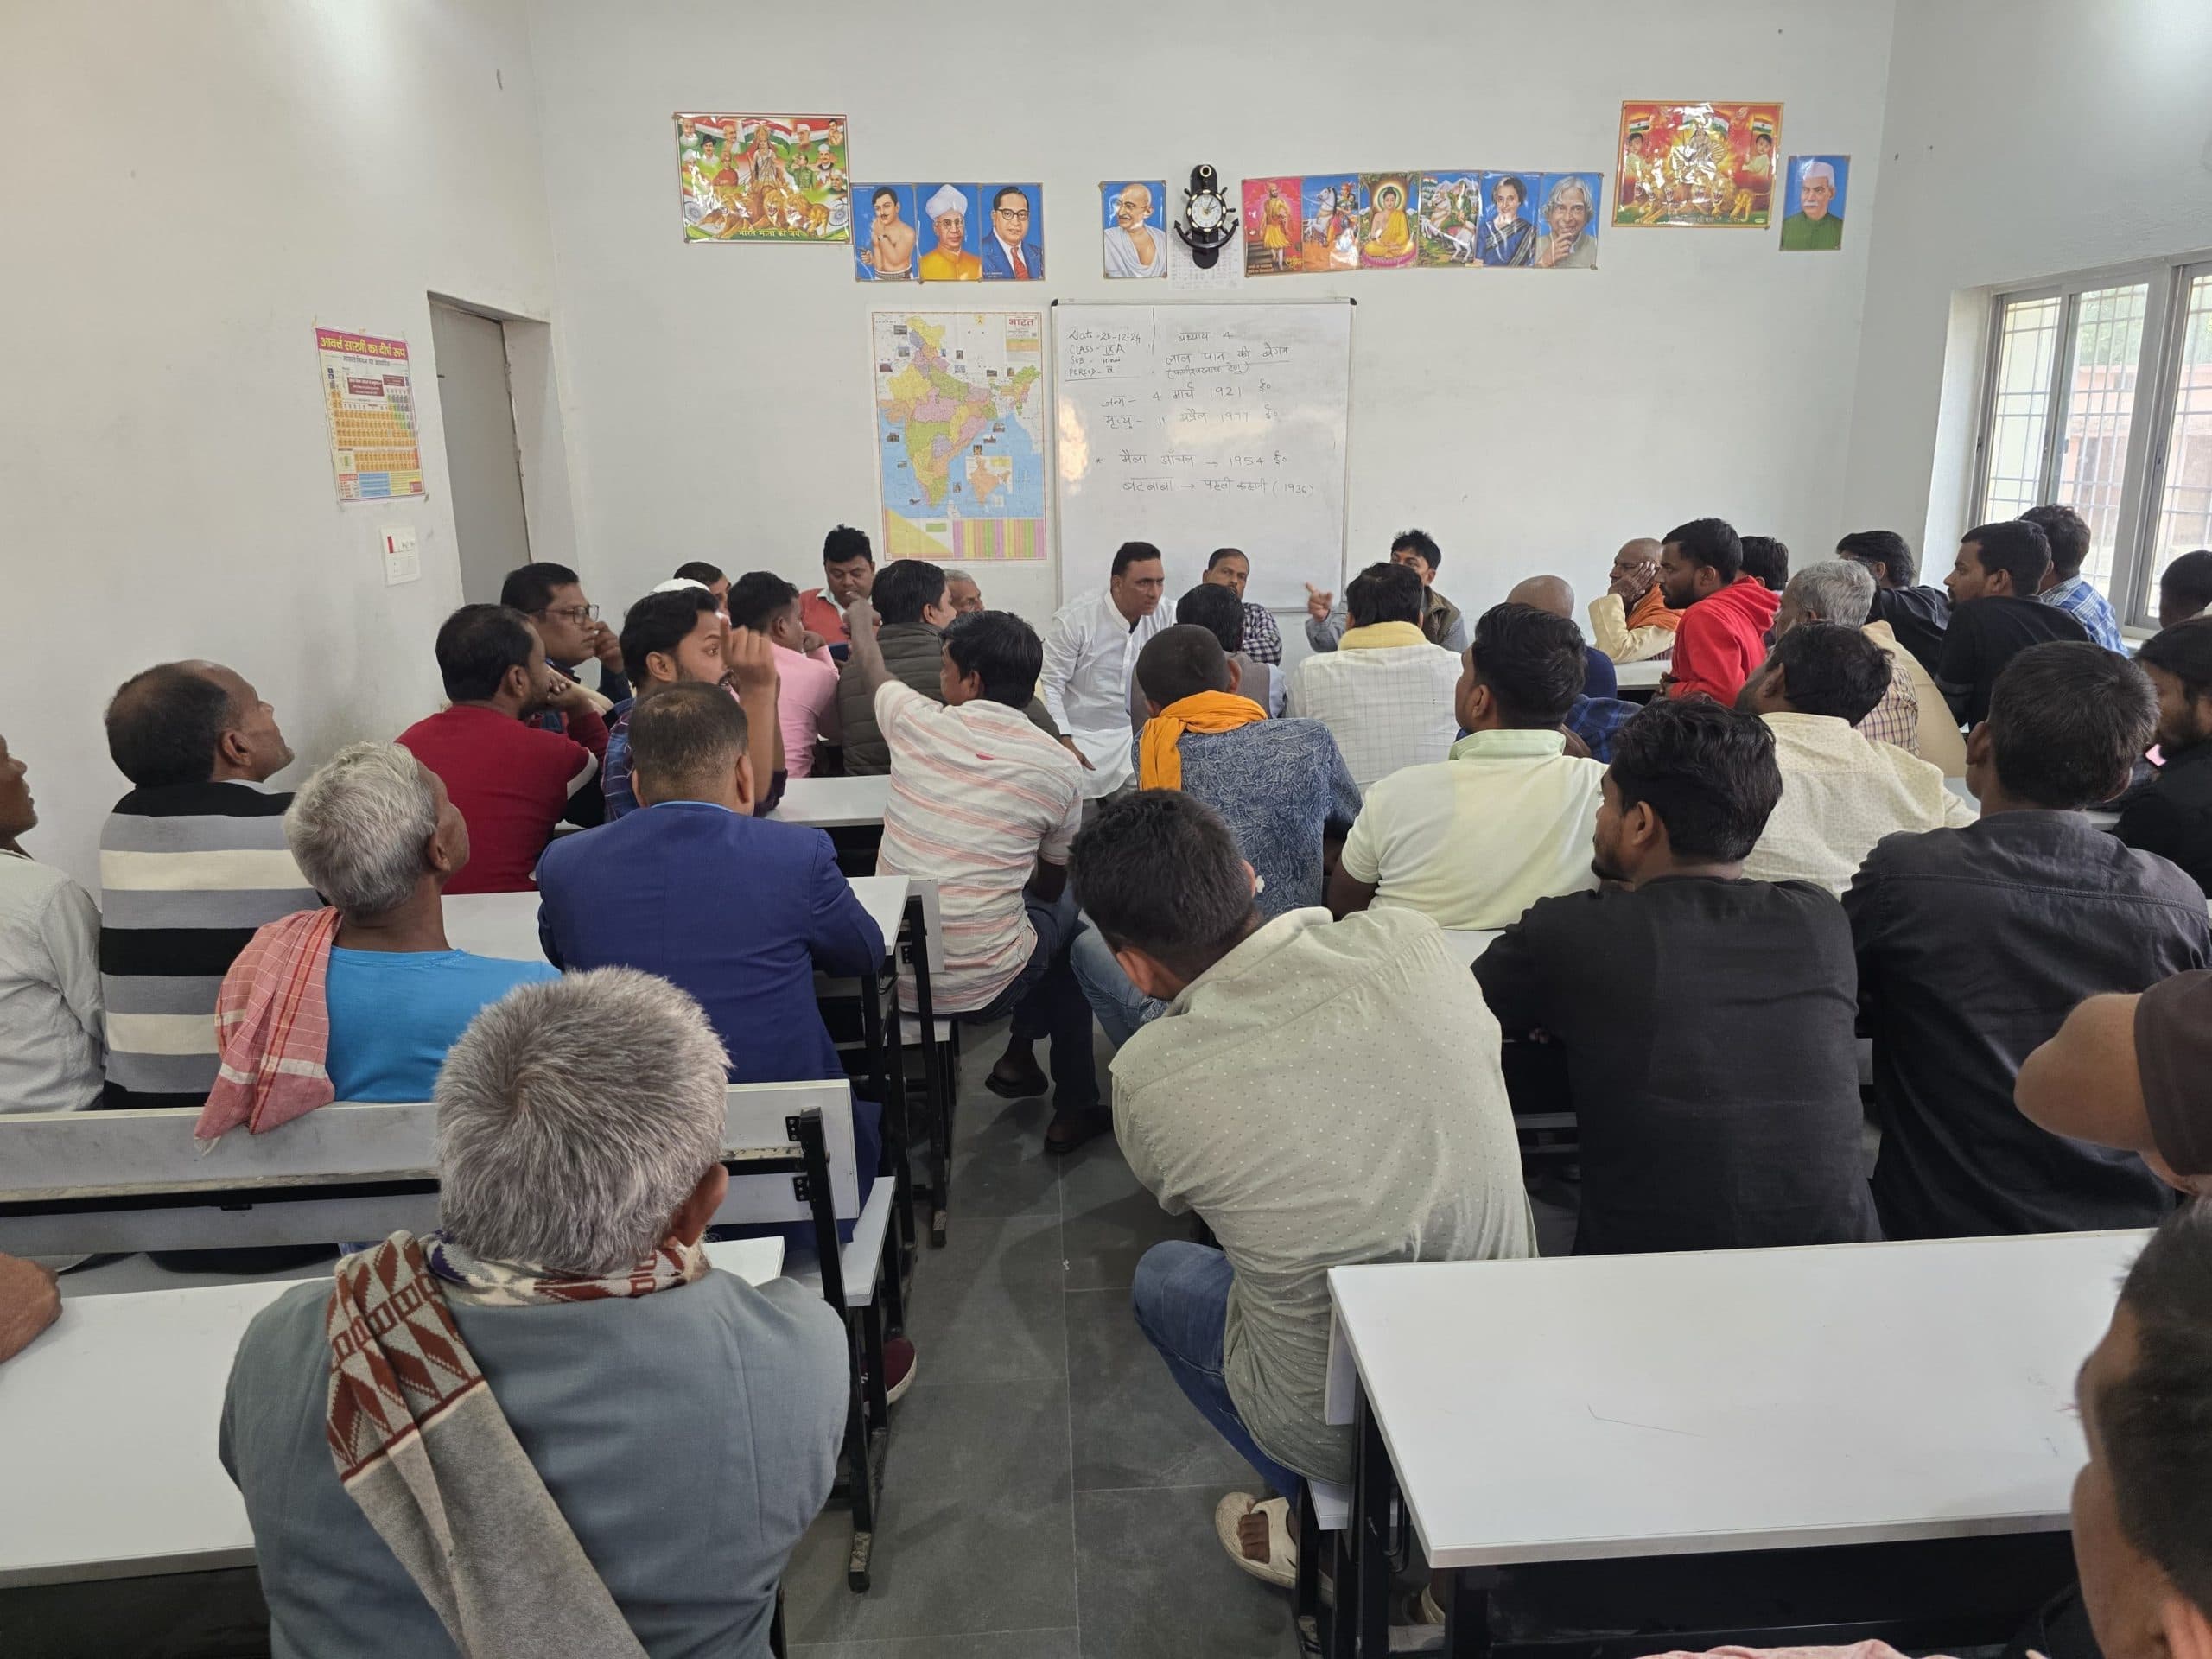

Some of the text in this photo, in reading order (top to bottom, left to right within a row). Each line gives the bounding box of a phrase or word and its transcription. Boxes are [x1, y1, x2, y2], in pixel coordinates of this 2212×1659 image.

[321, 336, 343, 350] आवर्त
[344, 339, 367, 353] सारणी
[367, 344, 378, 354] का
[392, 346, 406, 358] रूप
[1166, 353, 1193, 365] लाल
[1200, 352, 1226, 362] पान
[1237, 346, 1251, 359] की
[1172, 381, 1196, 400] मार्च
[1210, 386, 1243, 398] 1921
[1119, 448, 1148, 464] मैला
[1230, 455, 1263, 467] 1954
[1200, 476, 1235, 496] पहली
